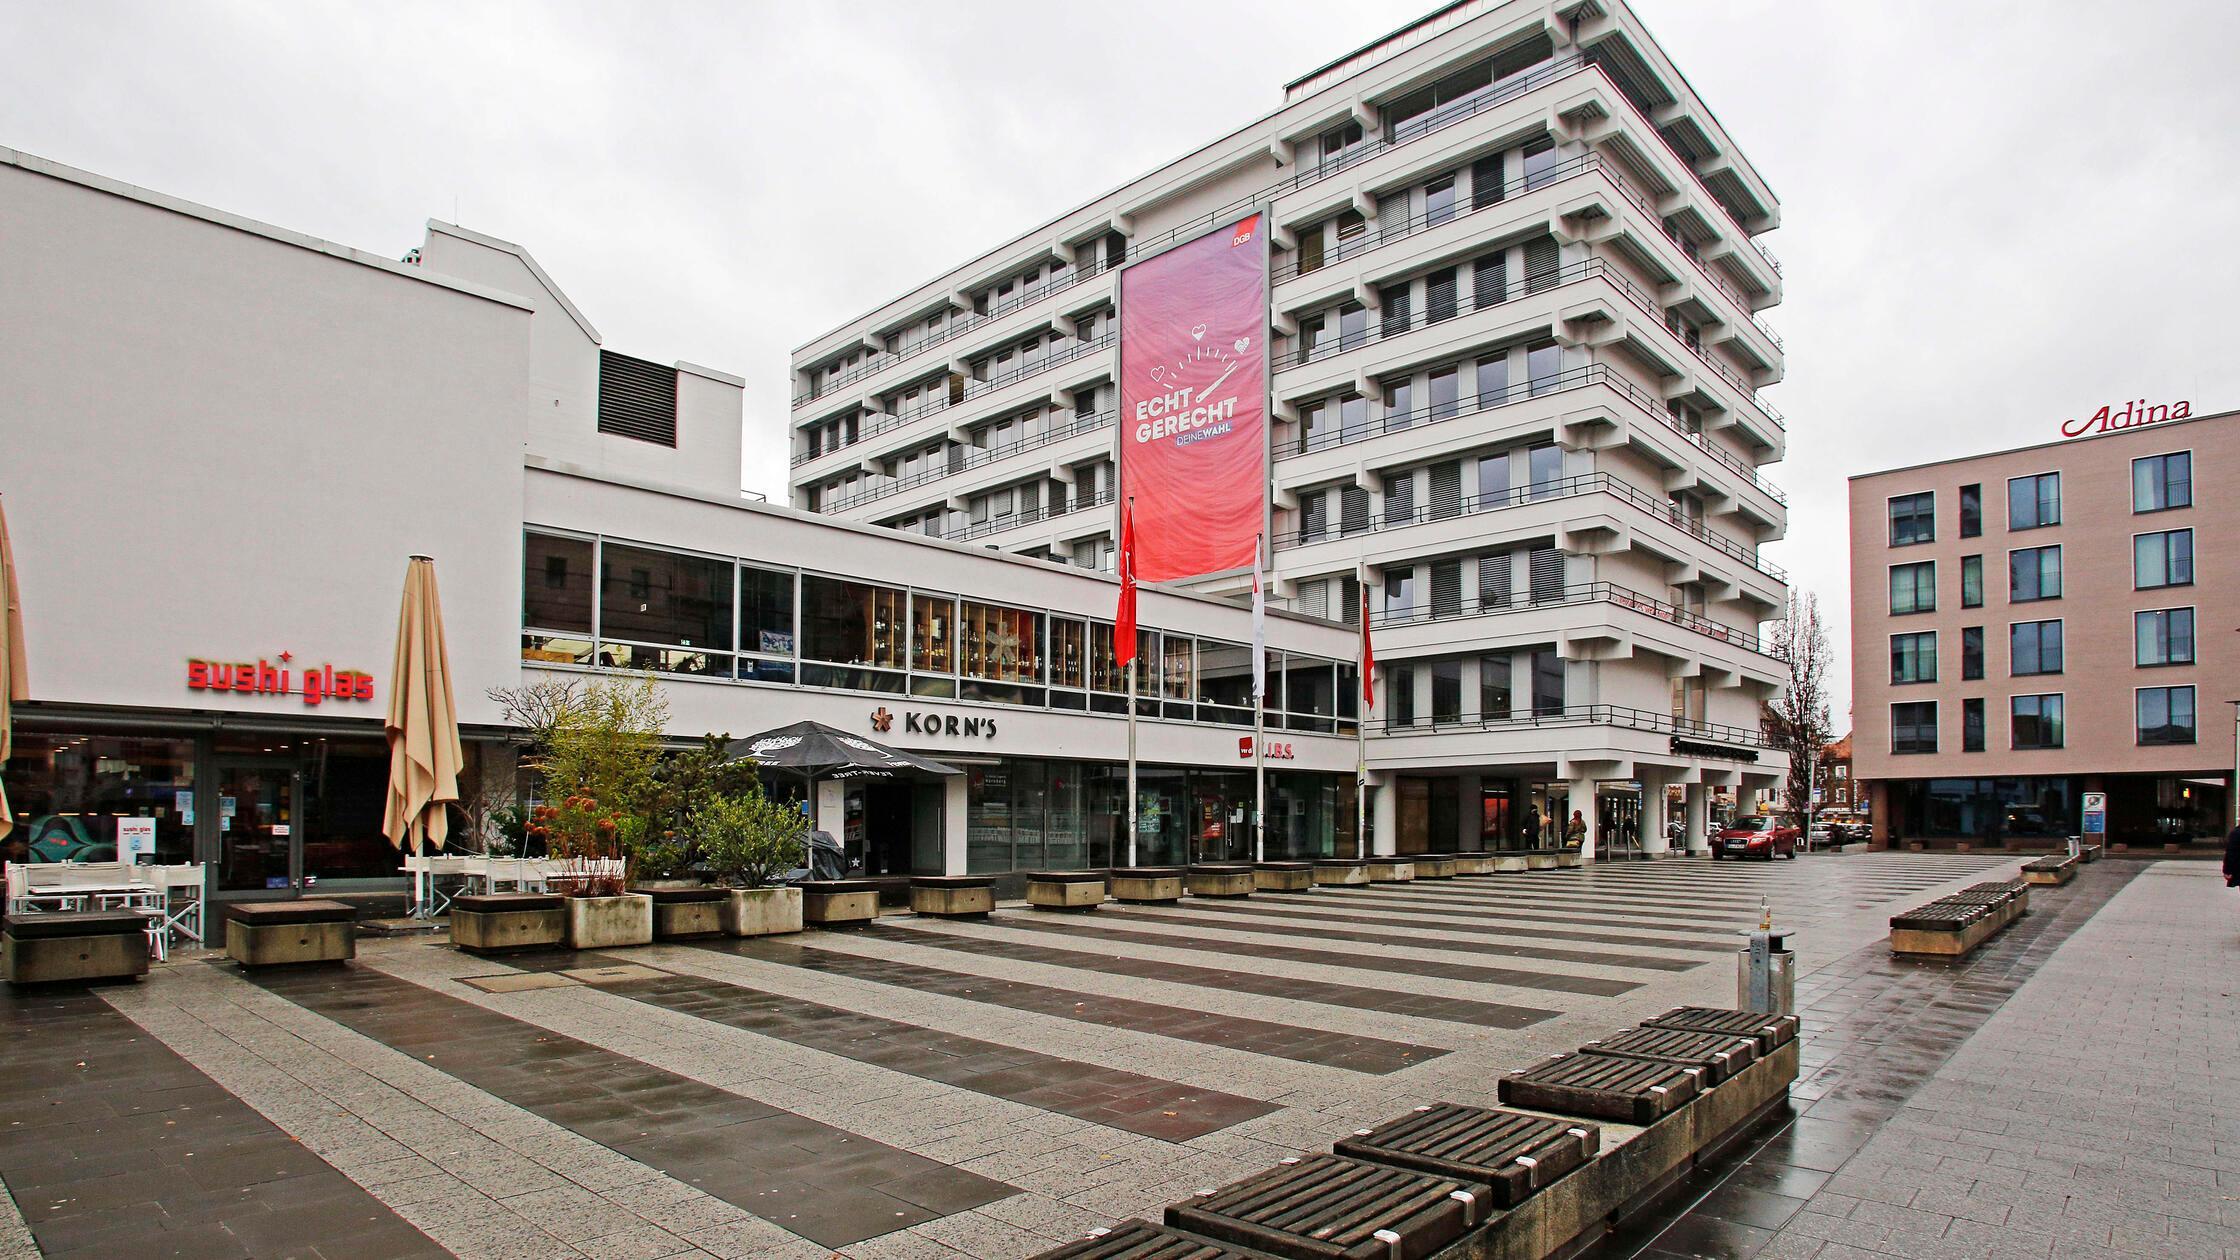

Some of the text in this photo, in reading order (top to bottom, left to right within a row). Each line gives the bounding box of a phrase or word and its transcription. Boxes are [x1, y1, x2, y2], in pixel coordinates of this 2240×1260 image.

[1233, 232, 1250, 246] DGB
[1136, 386, 1193, 421] ECHT
[1136, 396, 1238, 443] GERECHT
[2061, 398, 2193, 437] Adina
[1176, 423, 1231, 446] DEINEWAHL
[188, 652, 374, 705] sushi glas
[906, 711, 997, 738] KORN'S
